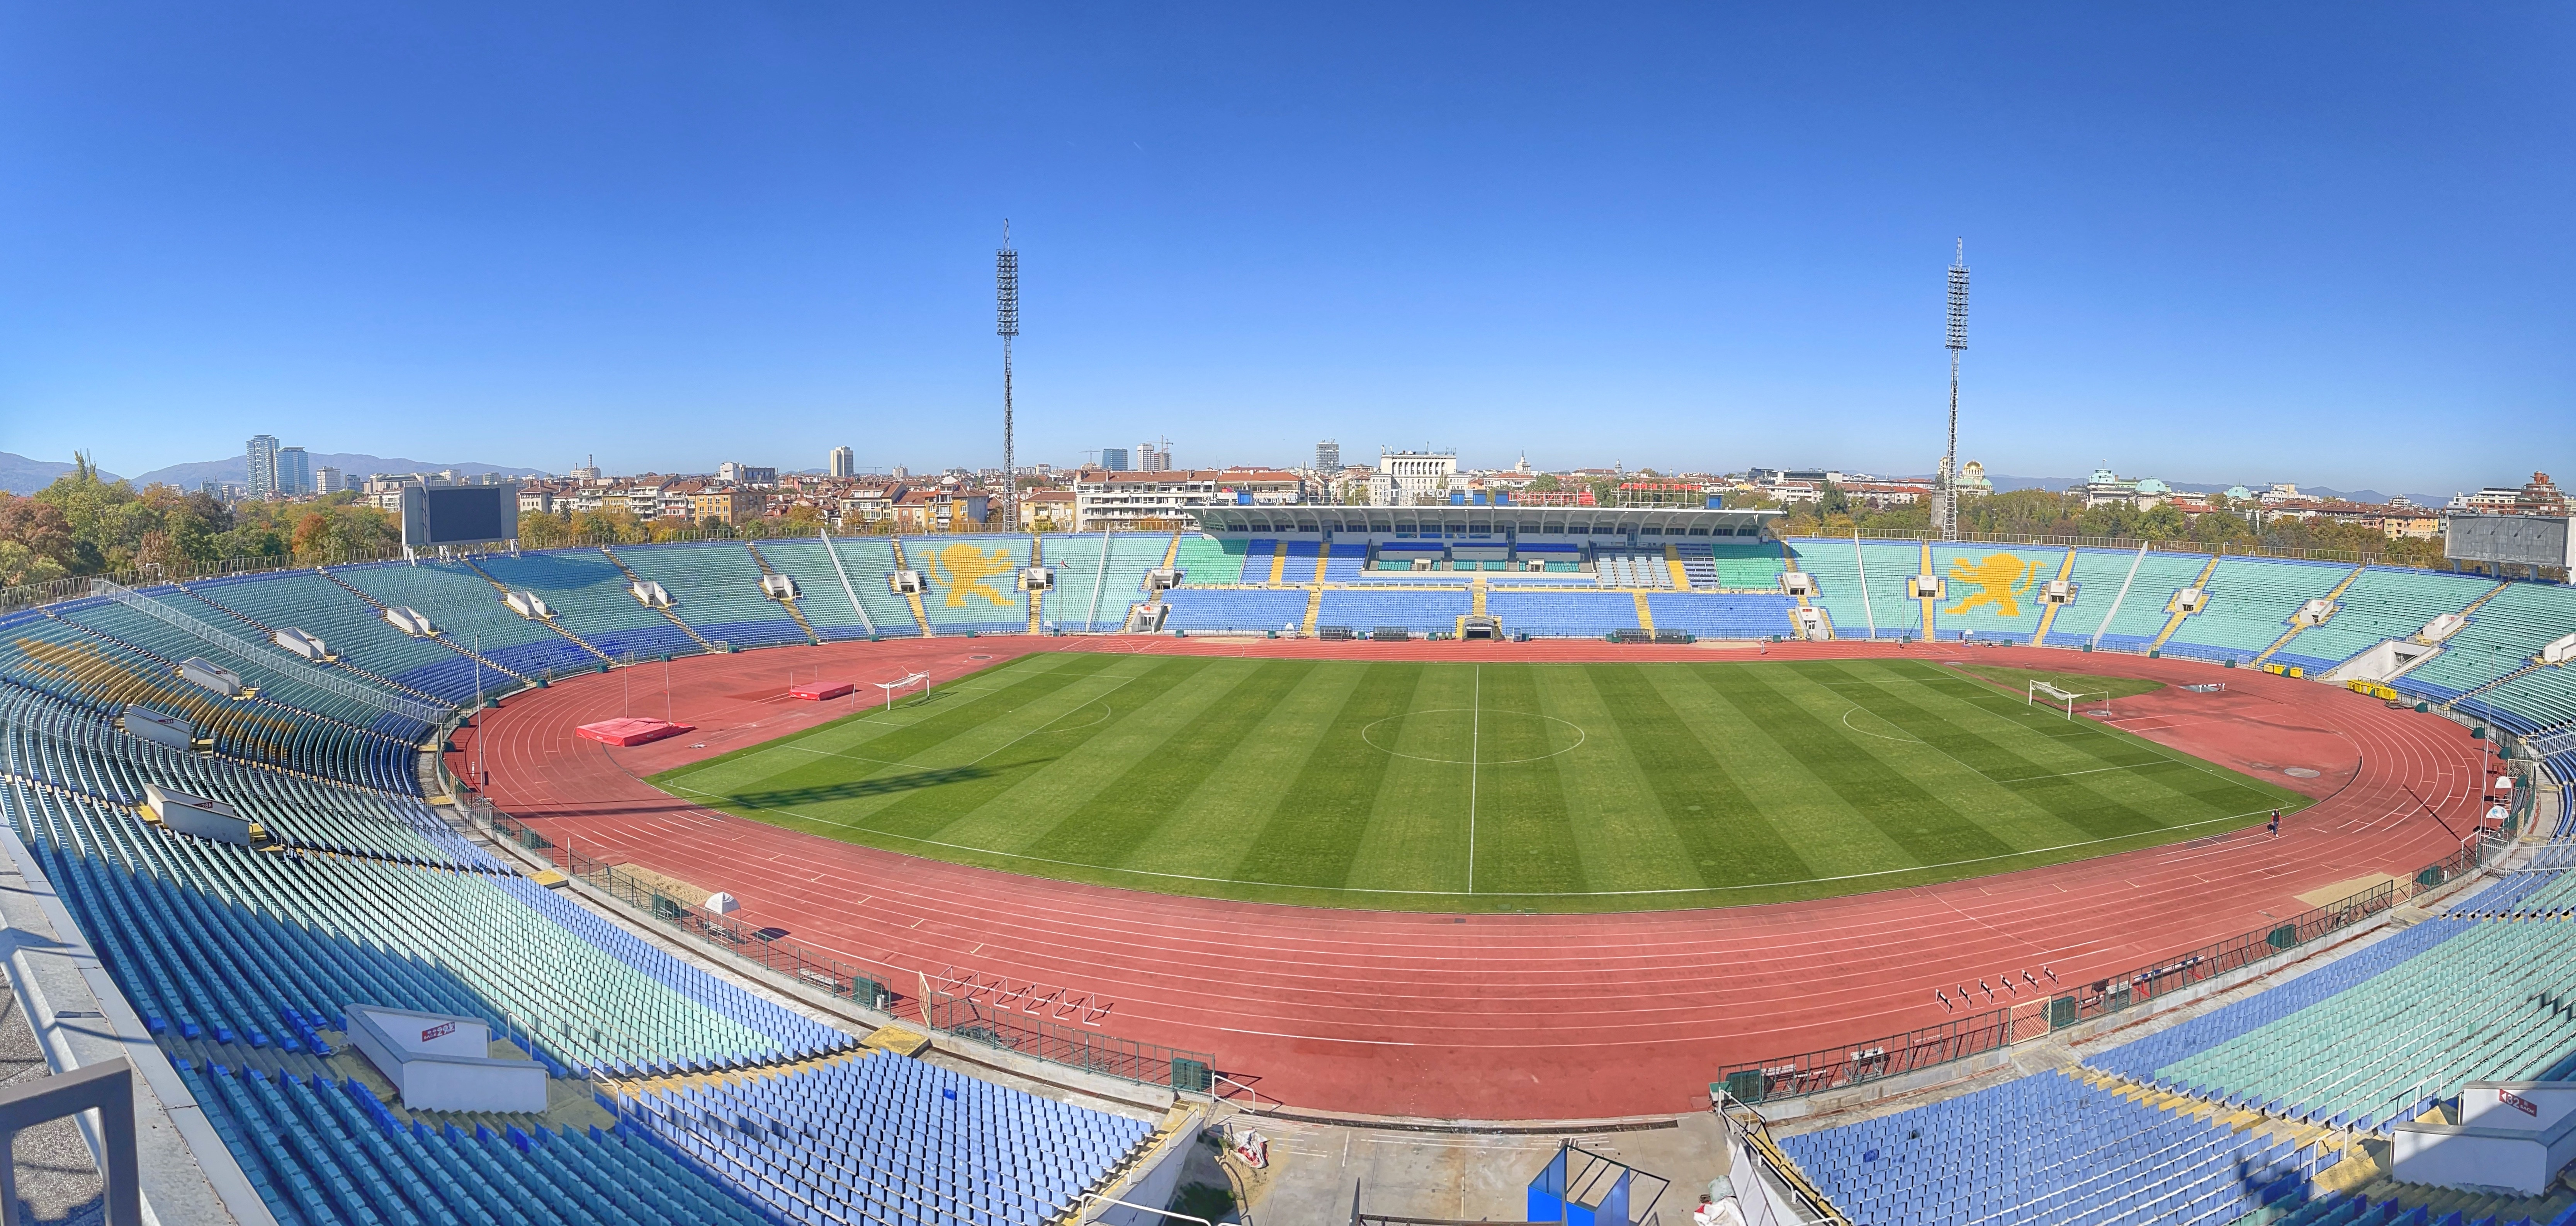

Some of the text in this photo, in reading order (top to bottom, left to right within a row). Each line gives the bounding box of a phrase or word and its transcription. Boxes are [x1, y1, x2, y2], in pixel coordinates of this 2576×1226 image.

[437, 1025, 448, 1036] 29
[2506, 1094, 2535, 1114] 32 БЛОК
